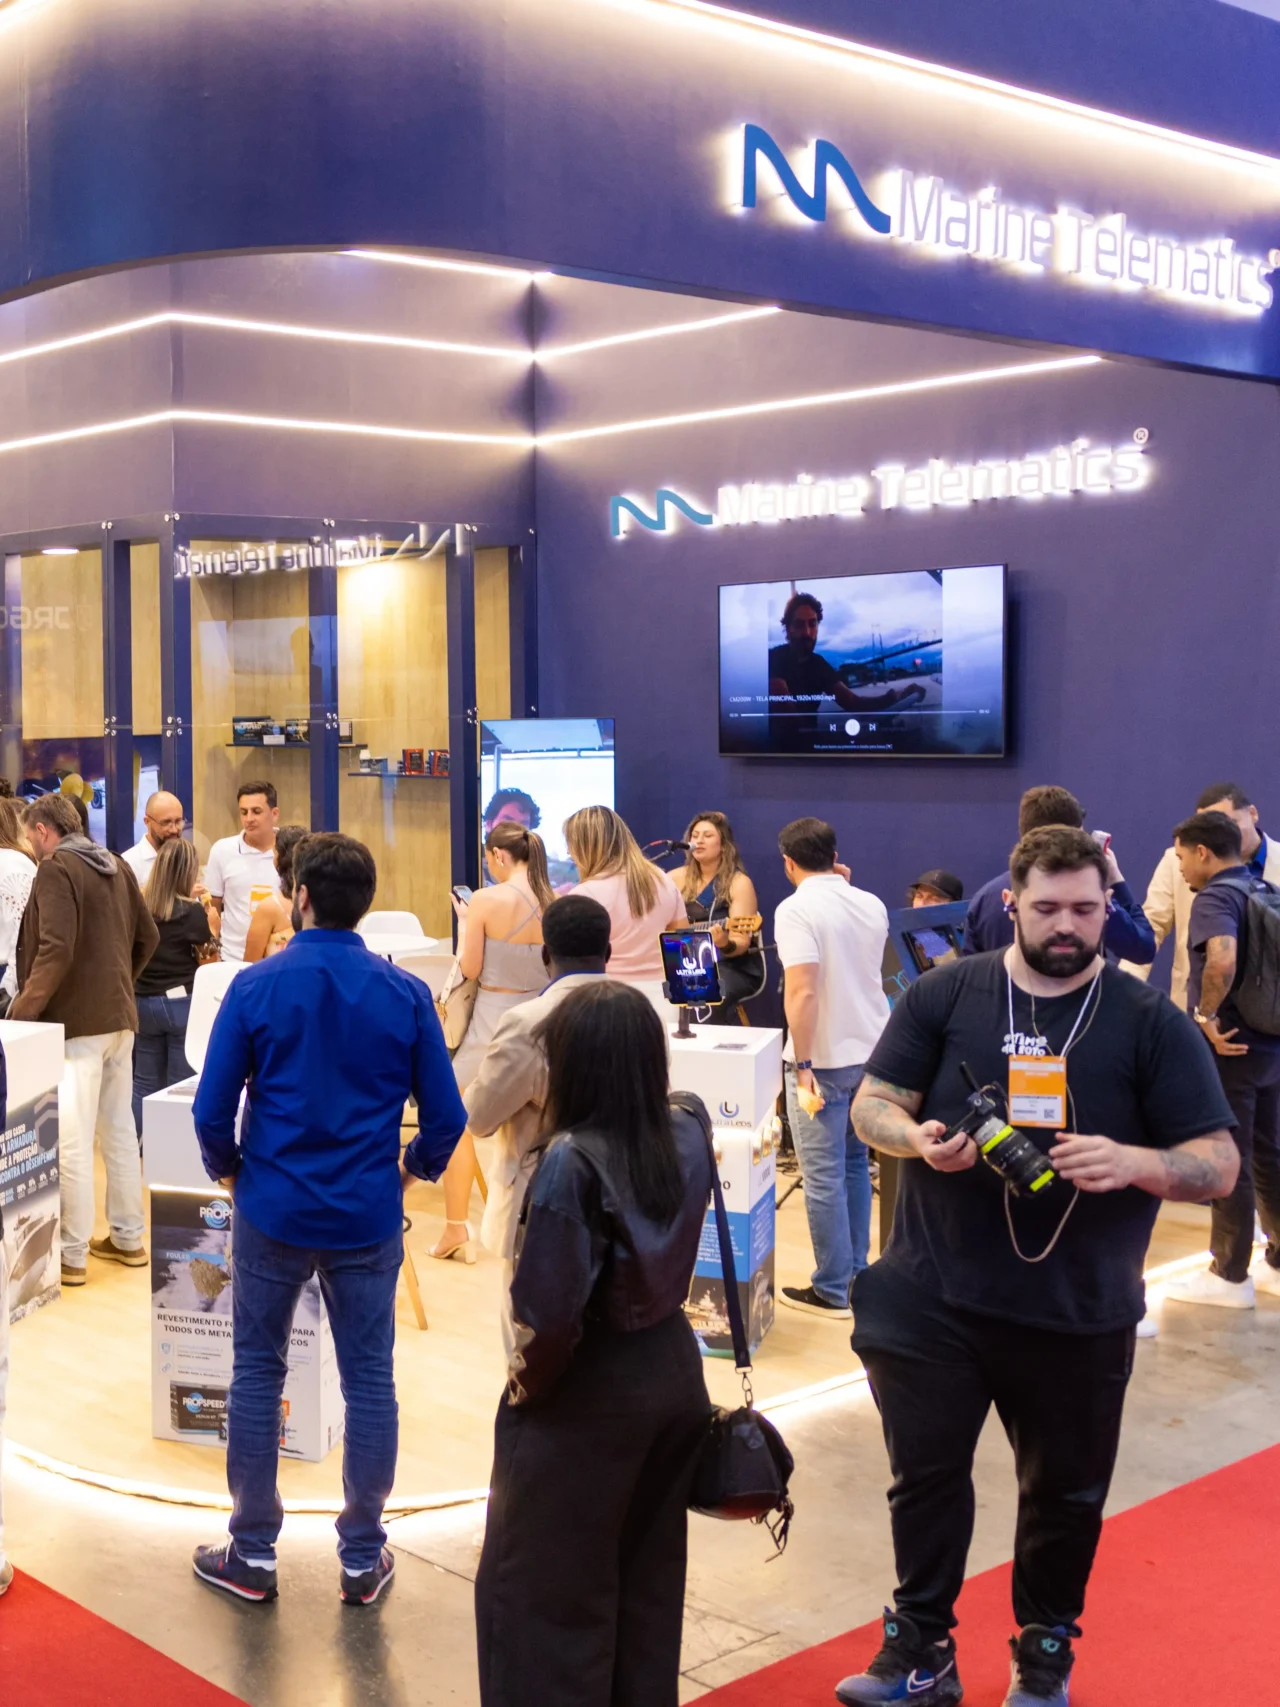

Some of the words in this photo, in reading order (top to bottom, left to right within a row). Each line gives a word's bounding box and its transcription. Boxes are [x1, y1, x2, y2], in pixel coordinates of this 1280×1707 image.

[899, 169, 1054, 268] Marine
[719, 472, 864, 526] Marine
[157, 1313, 223, 1327] REVESTIMENTO
[292, 1328, 315, 1337] PARA
[164, 1324, 193, 1335] TODOS
[194, 1327, 206, 1336] OS
[208, 1329, 232, 1338] META
